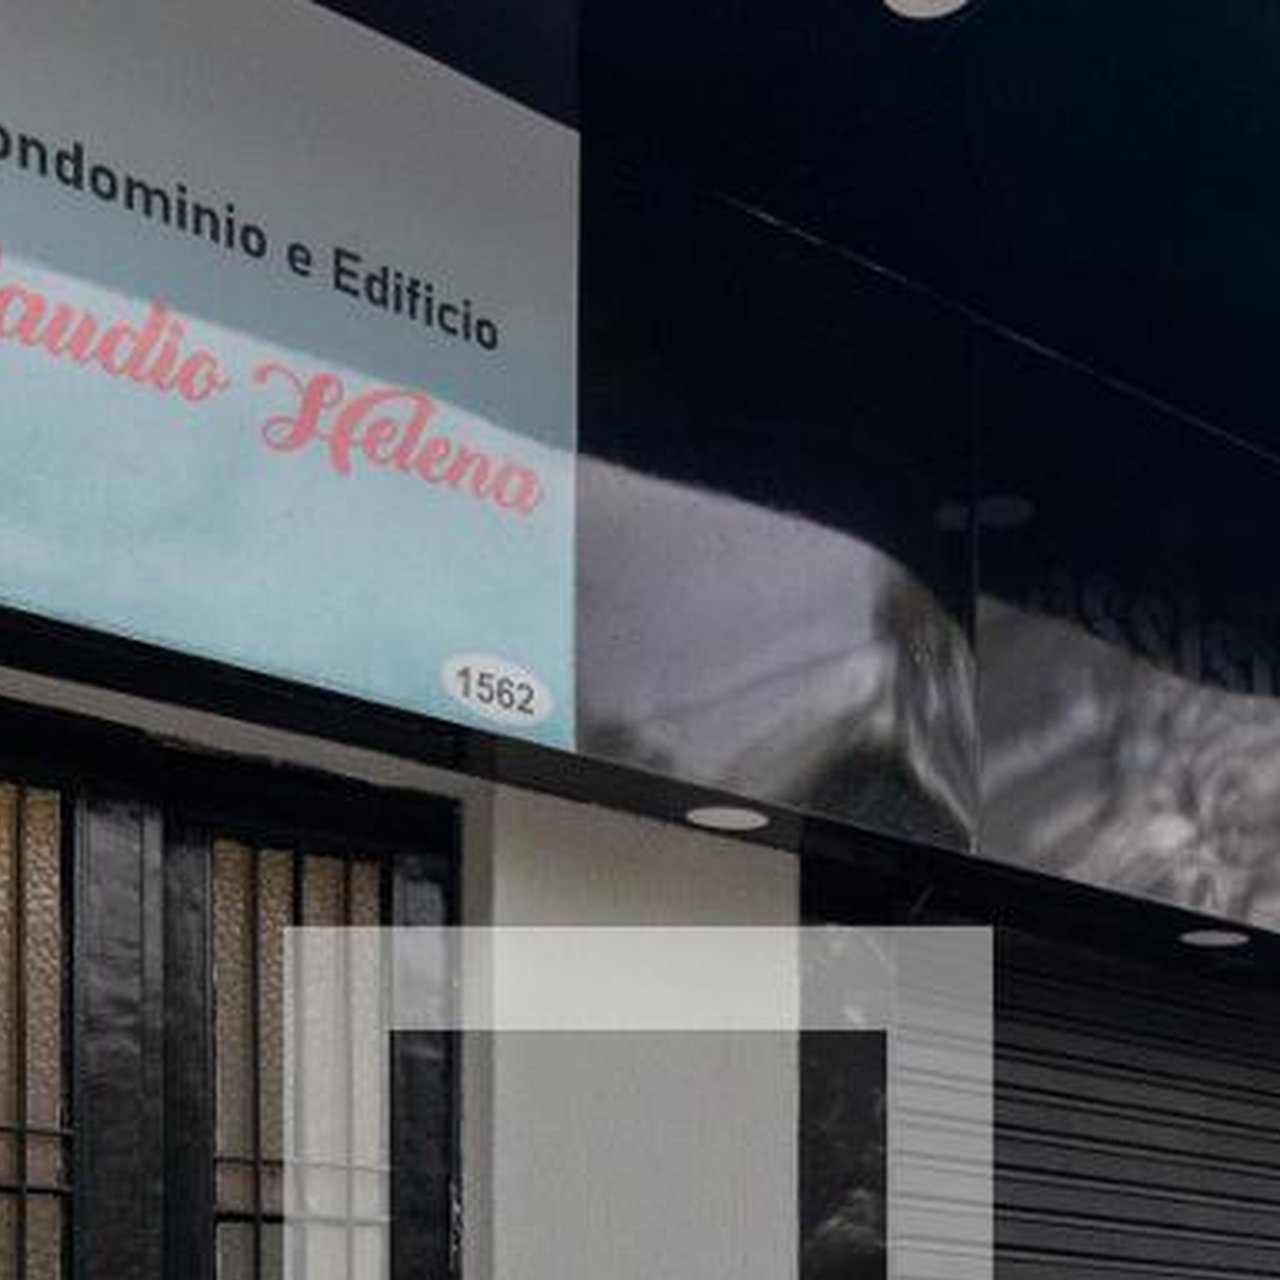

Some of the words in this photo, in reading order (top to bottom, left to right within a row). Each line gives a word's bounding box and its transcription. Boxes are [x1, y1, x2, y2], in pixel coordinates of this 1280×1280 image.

[286, 235, 314, 278] e
[332, 249, 500, 353] Edificio
[253, 355, 543, 517] Helena
[454, 666, 536, 715] 1562
